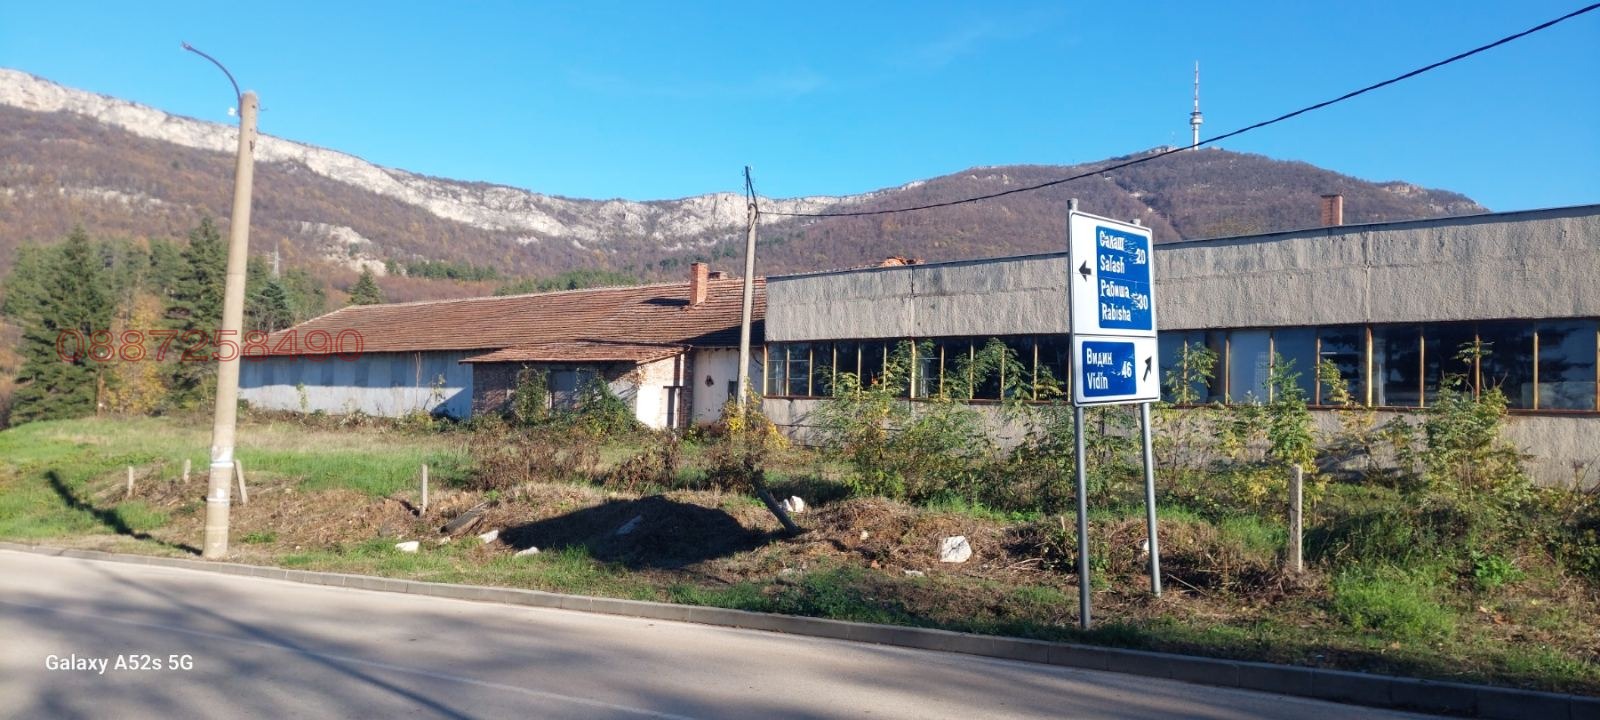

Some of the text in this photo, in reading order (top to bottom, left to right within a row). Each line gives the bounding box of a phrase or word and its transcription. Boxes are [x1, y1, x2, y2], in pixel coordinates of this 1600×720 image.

[1100, 254, 1125, 273] Salash
[1136, 248, 1146, 265] 20
[1100, 280, 1130, 299] Рабиша
[1101, 303, 1132, 321] Rabisha
[1086, 347, 1113, 367] Видин
[1121, 361, 1133, 378] 46
[1087, 372, 1109, 389] Vidin
